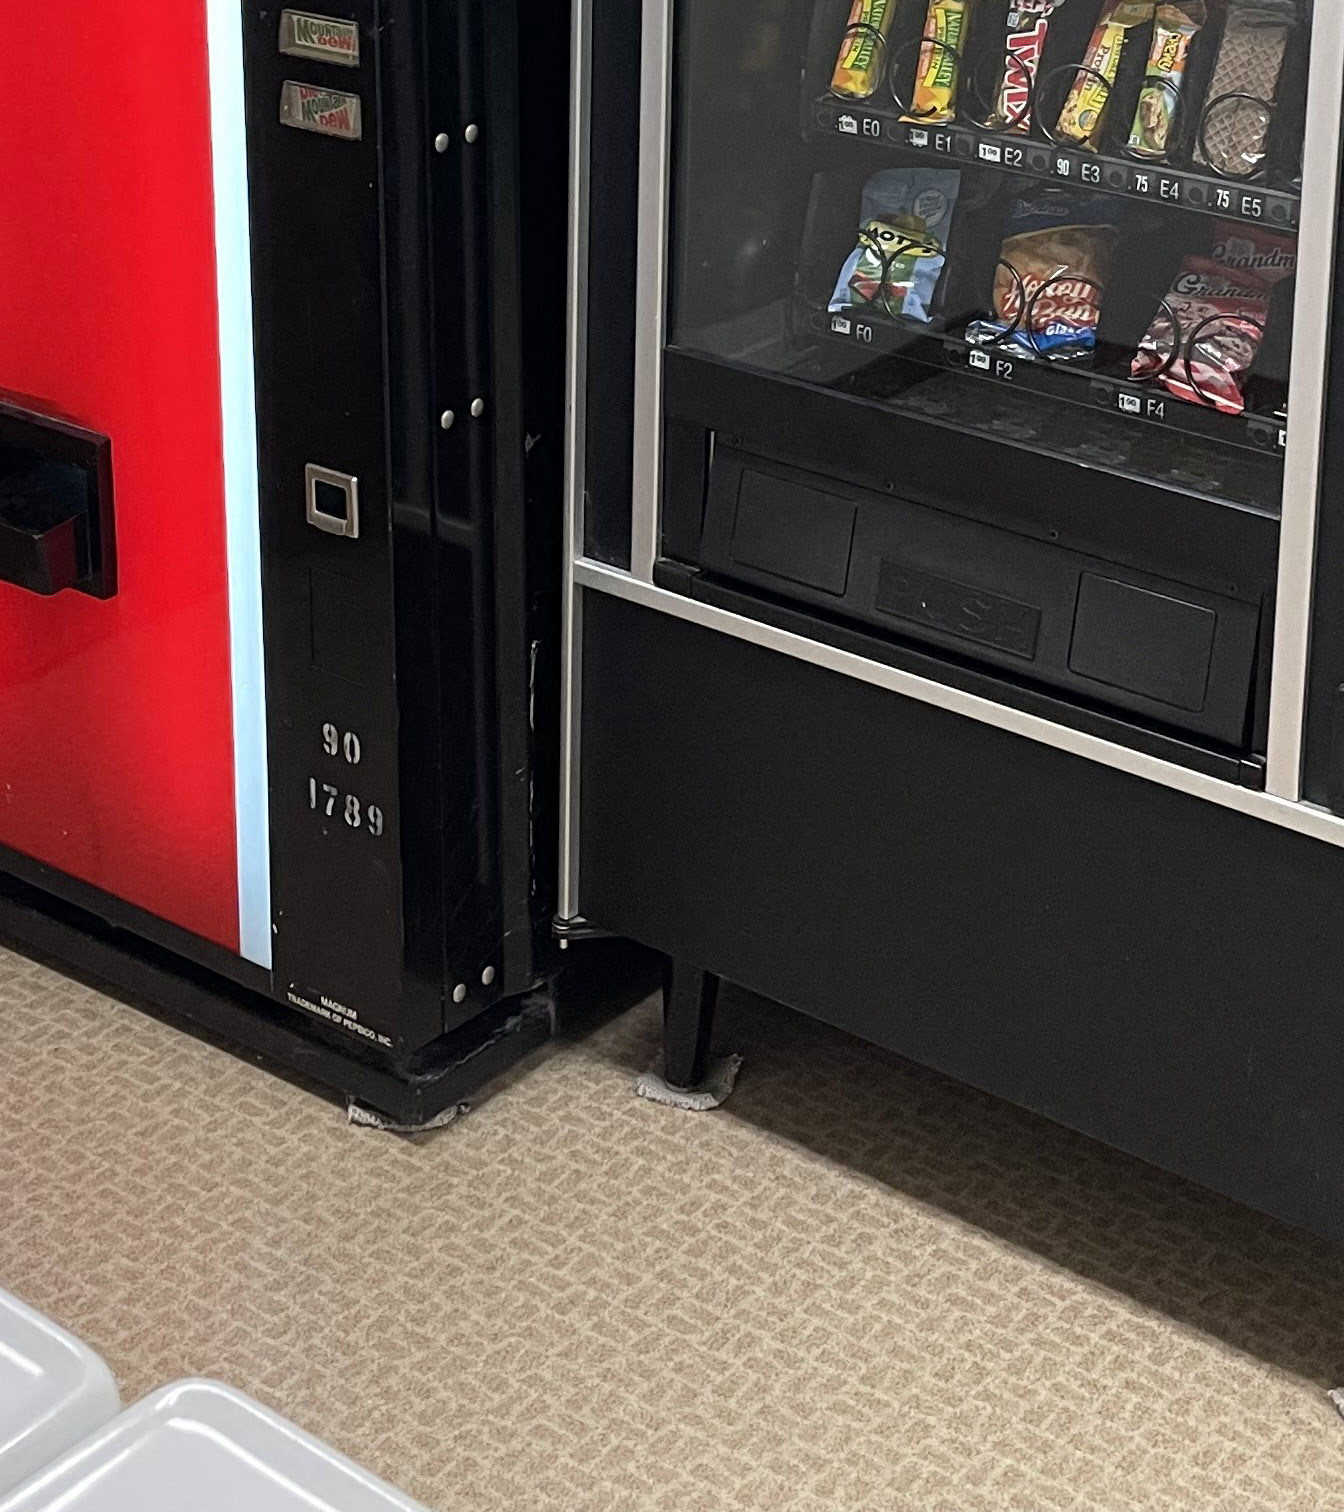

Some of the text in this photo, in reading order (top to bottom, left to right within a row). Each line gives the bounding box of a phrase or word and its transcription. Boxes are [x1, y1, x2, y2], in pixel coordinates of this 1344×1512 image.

[297, 16, 354, 44] MOUNTAIN
[317, 34, 353, 50] DEW
[1005, 19, 1049, 130] TWIX
[1084, 44, 1111, 91] Protin
[301, 95, 348, 124] MOUNTAIN
[320, 112, 350, 130] DEW
[862, 119, 880, 136] E0
[935, 135, 951, 152] E1
[1004, 150, 1023, 168] E2
[1081, 163, 1100, 183] E3
[1160, 180, 1180, 200] E4
[1241, 197, 1262, 217] E5
[856, 325, 872, 342] F0
[996, 360, 1013, 380] F2
[1146, 400, 1165, 419] F4
[322, 723, 361, 764] 90
[309, 777, 383, 836] 1789
[287, 991, 332, 1019] TRADEMARK
[331, 1013, 343, 1024] OF
[320, 995, 358, 1020] MAGNUM
